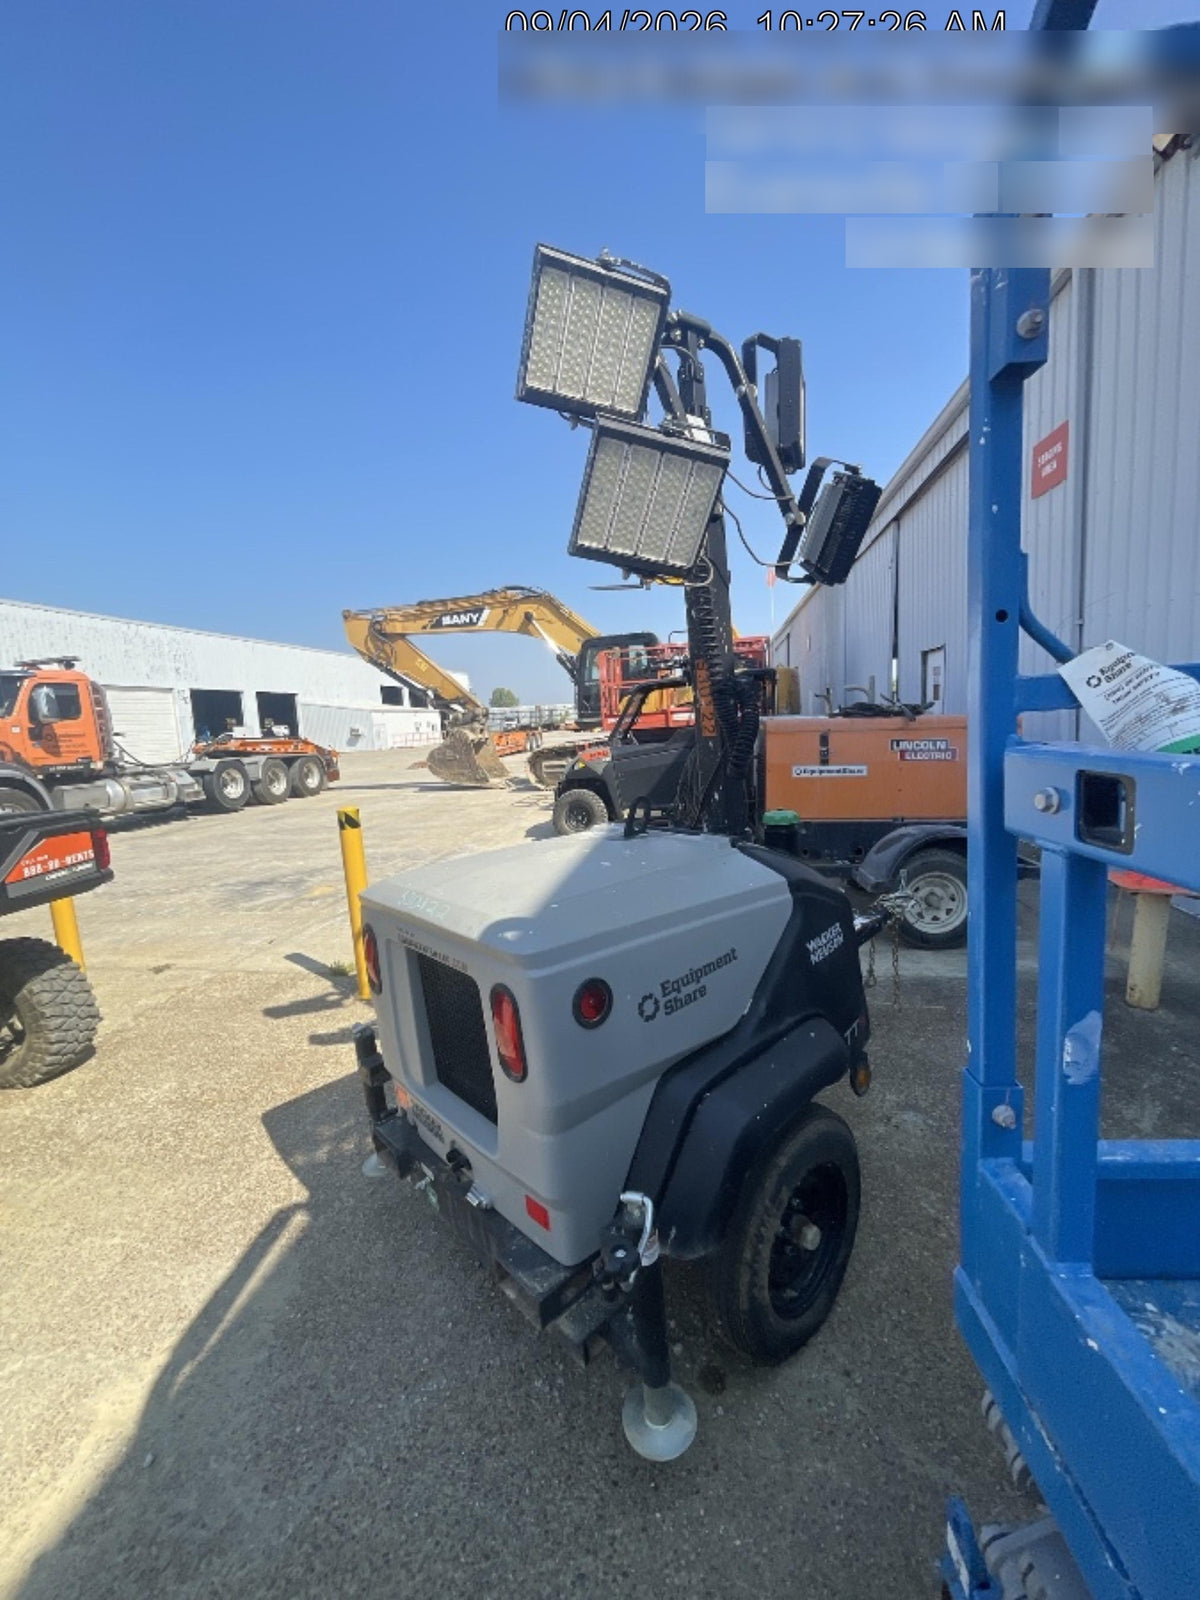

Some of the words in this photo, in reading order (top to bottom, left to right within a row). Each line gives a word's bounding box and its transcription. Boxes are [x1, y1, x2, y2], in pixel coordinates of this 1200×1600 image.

[893, 740, 947, 750] LINCOLN
[905, 751, 952, 760] ELECTRIC
[806, 922, 842, 951] WACKER
[810, 934, 844, 965] NEUSON
[660, 947, 738, 998] Equipment
[664, 984, 707, 1016] Share
